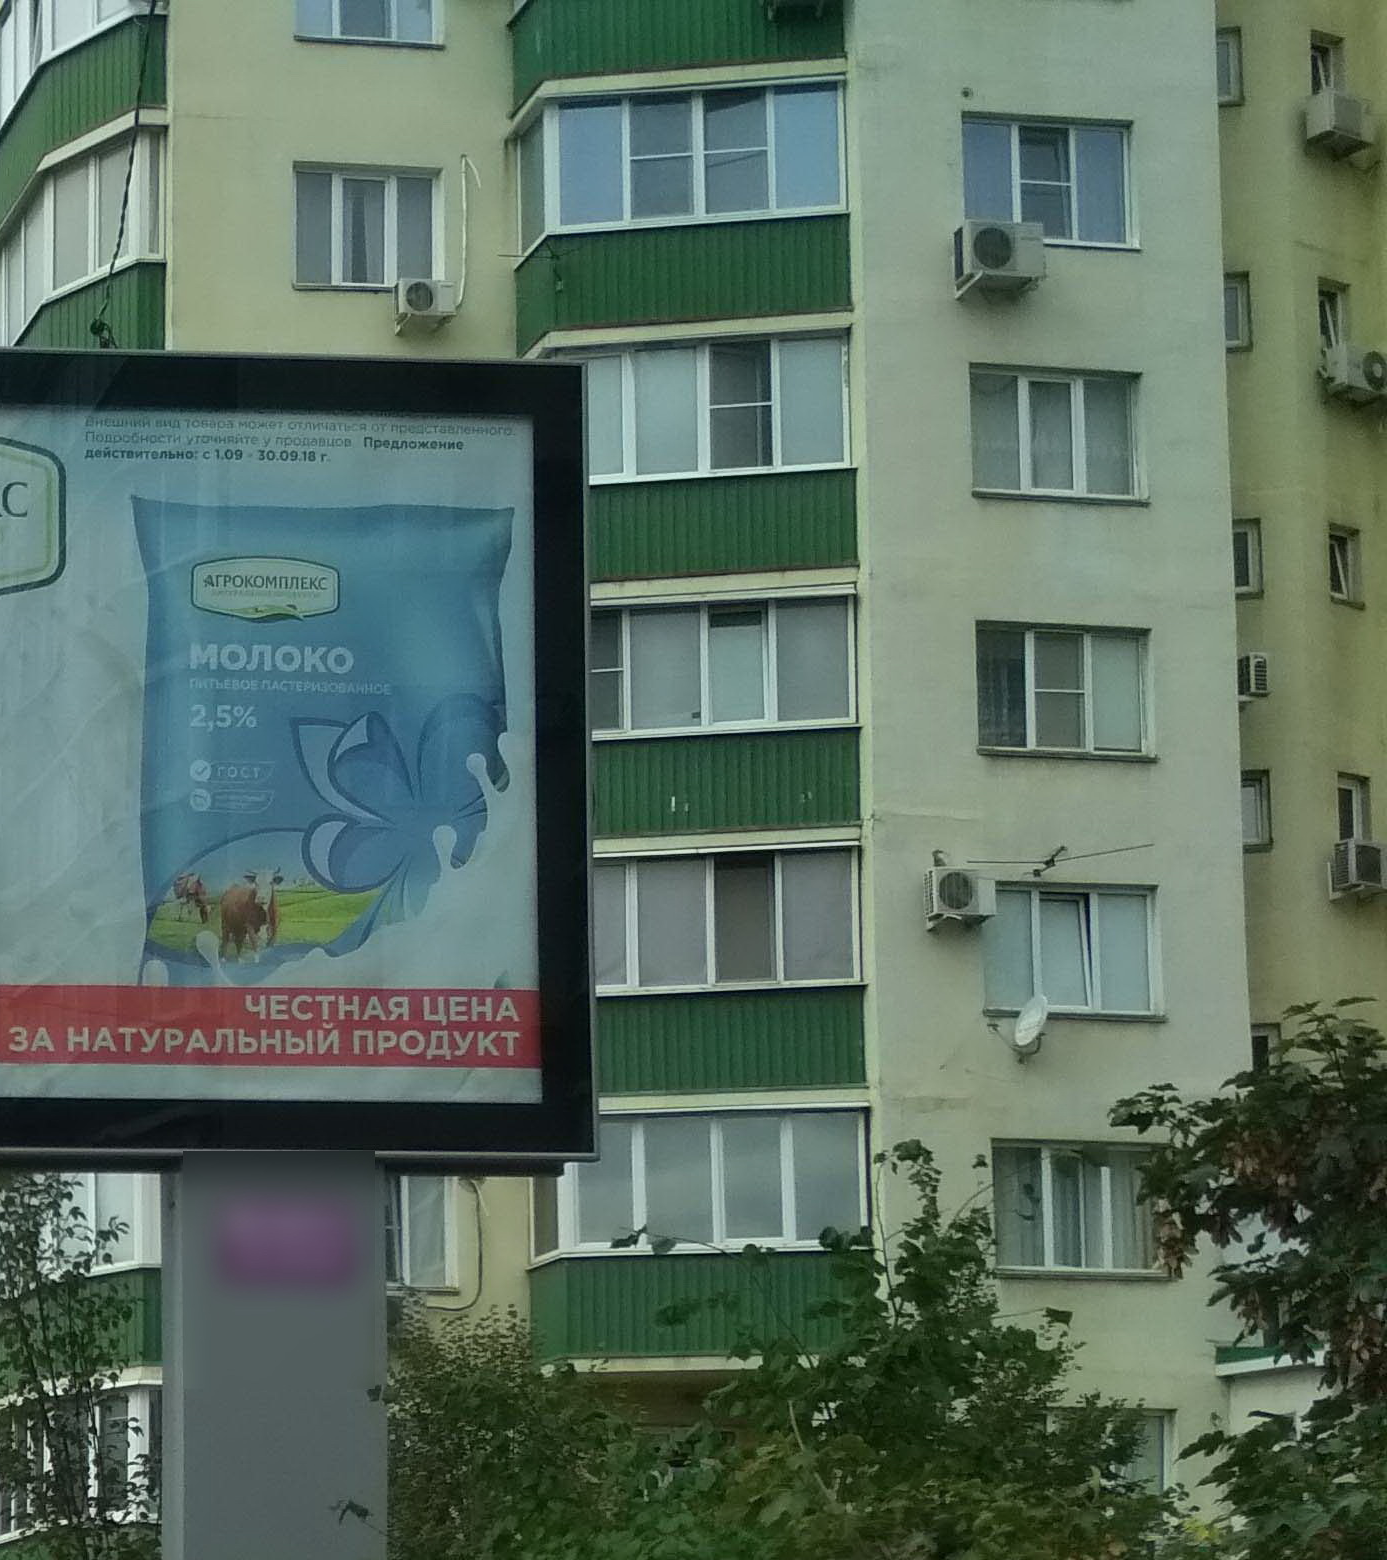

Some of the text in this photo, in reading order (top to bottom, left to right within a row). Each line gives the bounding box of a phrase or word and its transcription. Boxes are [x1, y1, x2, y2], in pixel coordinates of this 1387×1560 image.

[363, 436, 464, 451] Предложение
[84, 447, 199, 460] действительно:
[202, 451, 211, 460] с
[215, 448, 243, 461] 1.09
[257, 449, 317, 462] 30.09.18
[203, 574, 328, 590] АГРОКОМПЛЕКС
[189, 642, 355, 674] МОЛОКО
[189, 678, 393, 696] ПИТЬЕВОЕ ПАСТЕРИЗОВАННОЕ
[189, 704, 258, 731] 2,5%
[217, 765, 261, 778] ГОСТ
[244, 995, 520, 1026] ЧЕСТНАЯ ЦЕНА
[8, 1023, 521, 1058] ЗА НАТУРАЛЬНЫЙ ПРОДУКТ
